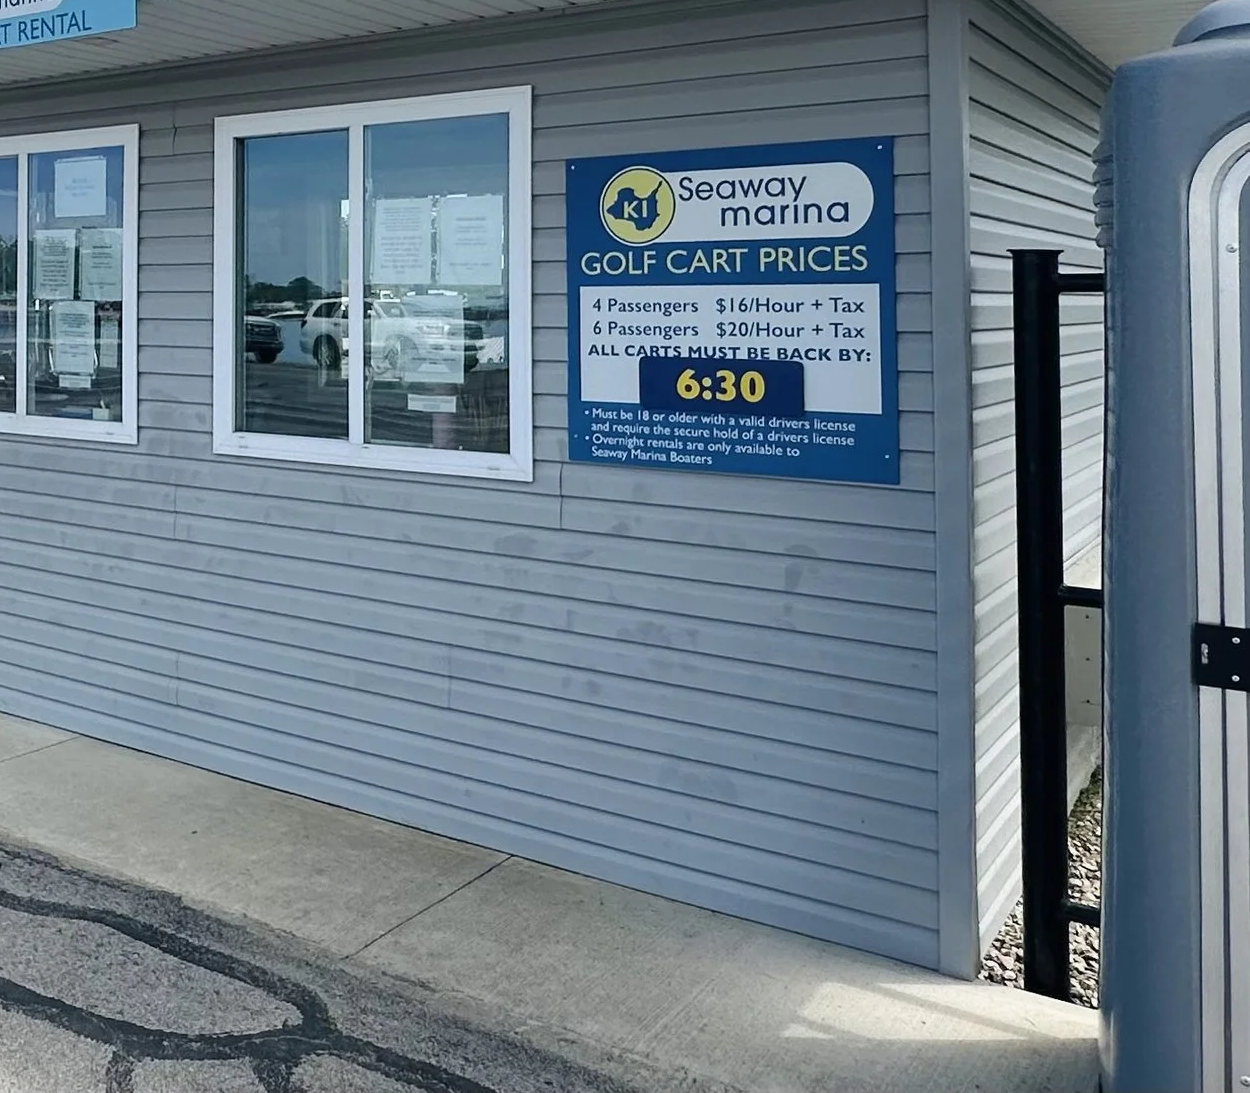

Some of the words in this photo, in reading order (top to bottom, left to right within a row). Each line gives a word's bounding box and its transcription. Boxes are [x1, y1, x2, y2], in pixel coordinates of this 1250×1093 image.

[18, 10, 92, 40] RENTAL
[678, 176, 807, 202] Seaway
[623, 200, 648, 219] KI
[720, 201, 850, 227] marina
[581, 250, 656, 276] GOLF
[666, 248, 748, 274] CART
[759, 245, 868, 272] PRICES
[592, 298, 601, 312] 4
[608, 298, 699, 317] Passengers
[715, 297, 804, 314] $16/Hour
[811, 299, 823, 310] +
[829, 297, 865, 313] Tax
[593, 321, 602, 335] 6
[608, 321, 699, 340] Passengers
[716, 322, 804, 338] $20/Hour
[812, 324, 824, 336] +
[829, 322, 865, 338] Tax
[588, 344, 619, 356] ALL
[624, 345, 681, 357] CARTS
[688, 346, 740, 359] MUST
[747, 347, 770, 359] BE
[777, 347, 832, 361] BACK
[839, 348, 871, 362] BY:
[676, 368, 766, 403] 6:30
[592, 408, 617, 419] Must
[620, 409, 633, 420] be
[637, 410, 650, 421] 18
[652, 413, 665, 422] or
[668, 412, 697, 423] older
[701, 414, 725, 425] with
[728, 417, 735, 426] a
[738, 415, 765, 427] valid
[768, 417, 810, 430] drivers
[814, 418, 856, 432] license
[591, 421, 609, 432] and
[612, 422, 650, 435] require
[653, 424, 671, 436] the
[674, 427, 710, 438] secure
[713, 427, 738, 439] hold
[742, 429, 754, 440] of
[757, 433, 764, 441] a
[767, 430, 809, 443] drivers
[812, 432, 855, 446] license
[592, 433, 644, 449] Overnight
[647, 438, 684, 449] rentals
[686, 442, 704, 451] are
[707, 441, 732, 455] only
[734, 443, 783, 456] available
[786, 447, 800, 457] to
[591, 445, 627, 461] Seaway
[630, 448, 666, 461] Marina
[670, 451, 713, 465] Boaters
